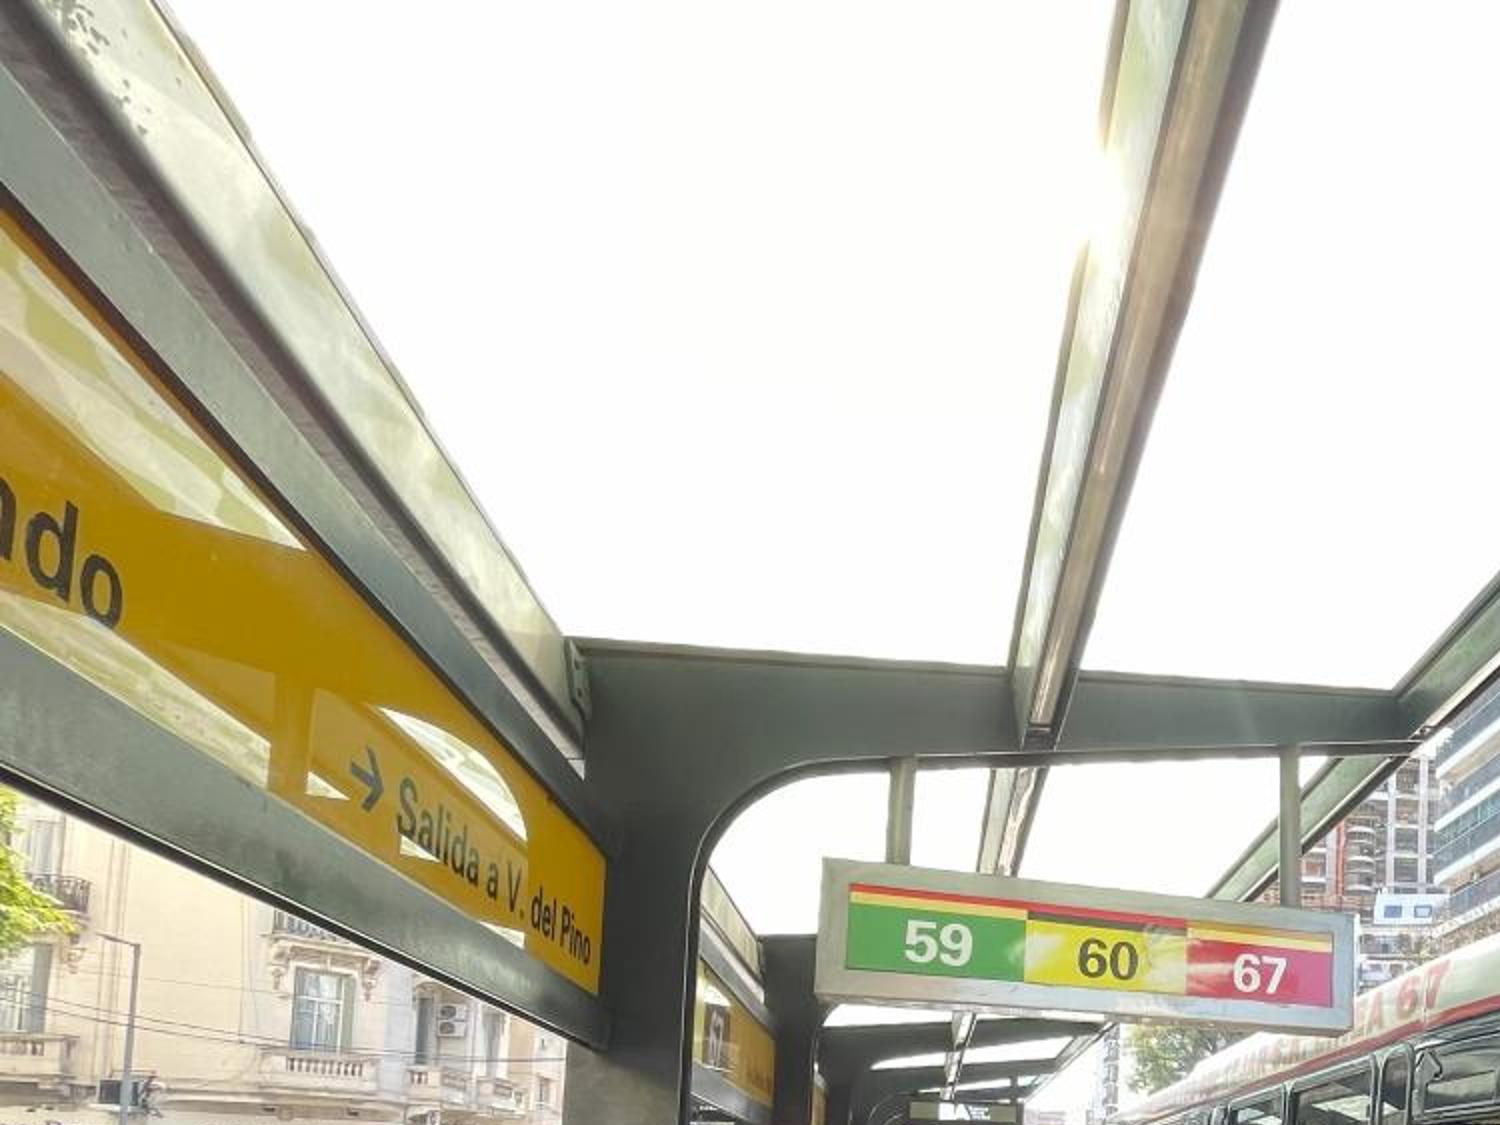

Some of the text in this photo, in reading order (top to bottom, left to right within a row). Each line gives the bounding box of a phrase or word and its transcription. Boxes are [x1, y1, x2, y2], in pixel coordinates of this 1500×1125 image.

[396, 777, 591, 966] Salida a V. del Pino
[904, 919, 973, 967] 59
[1077, 937, 1139, 981] 60
[1232, 953, 1288, 995] 67
[1395, 959, 1451, 1020] 67
